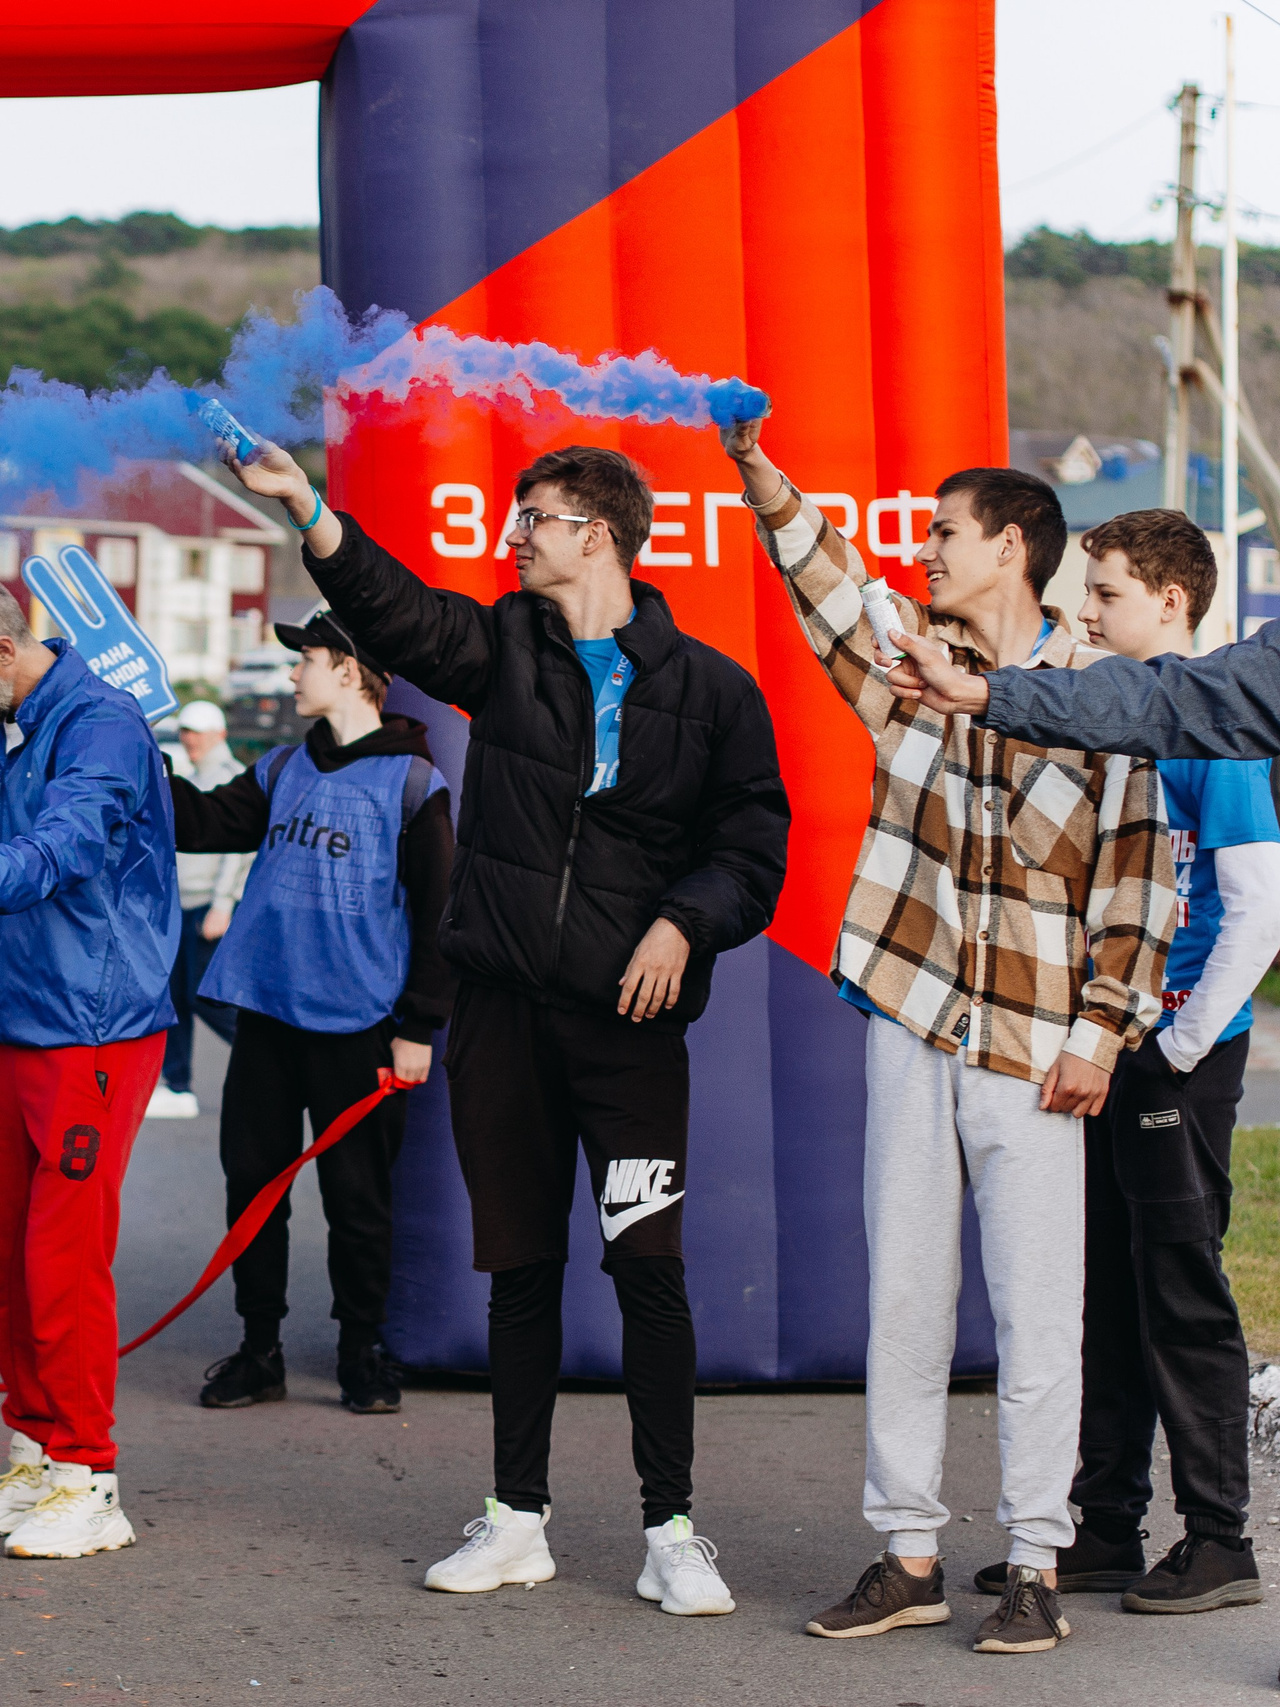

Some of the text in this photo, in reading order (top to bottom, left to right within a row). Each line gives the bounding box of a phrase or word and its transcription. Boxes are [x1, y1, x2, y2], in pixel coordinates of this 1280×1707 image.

[430, 483, 939, 568] ЗЕГРФ
[87, 641, 135, 676] РАНА
[616, 654, 630, 673] ПС
[59, 1124, 101, 1181] 8
[603, 1158, 676, 1205] NIKE
